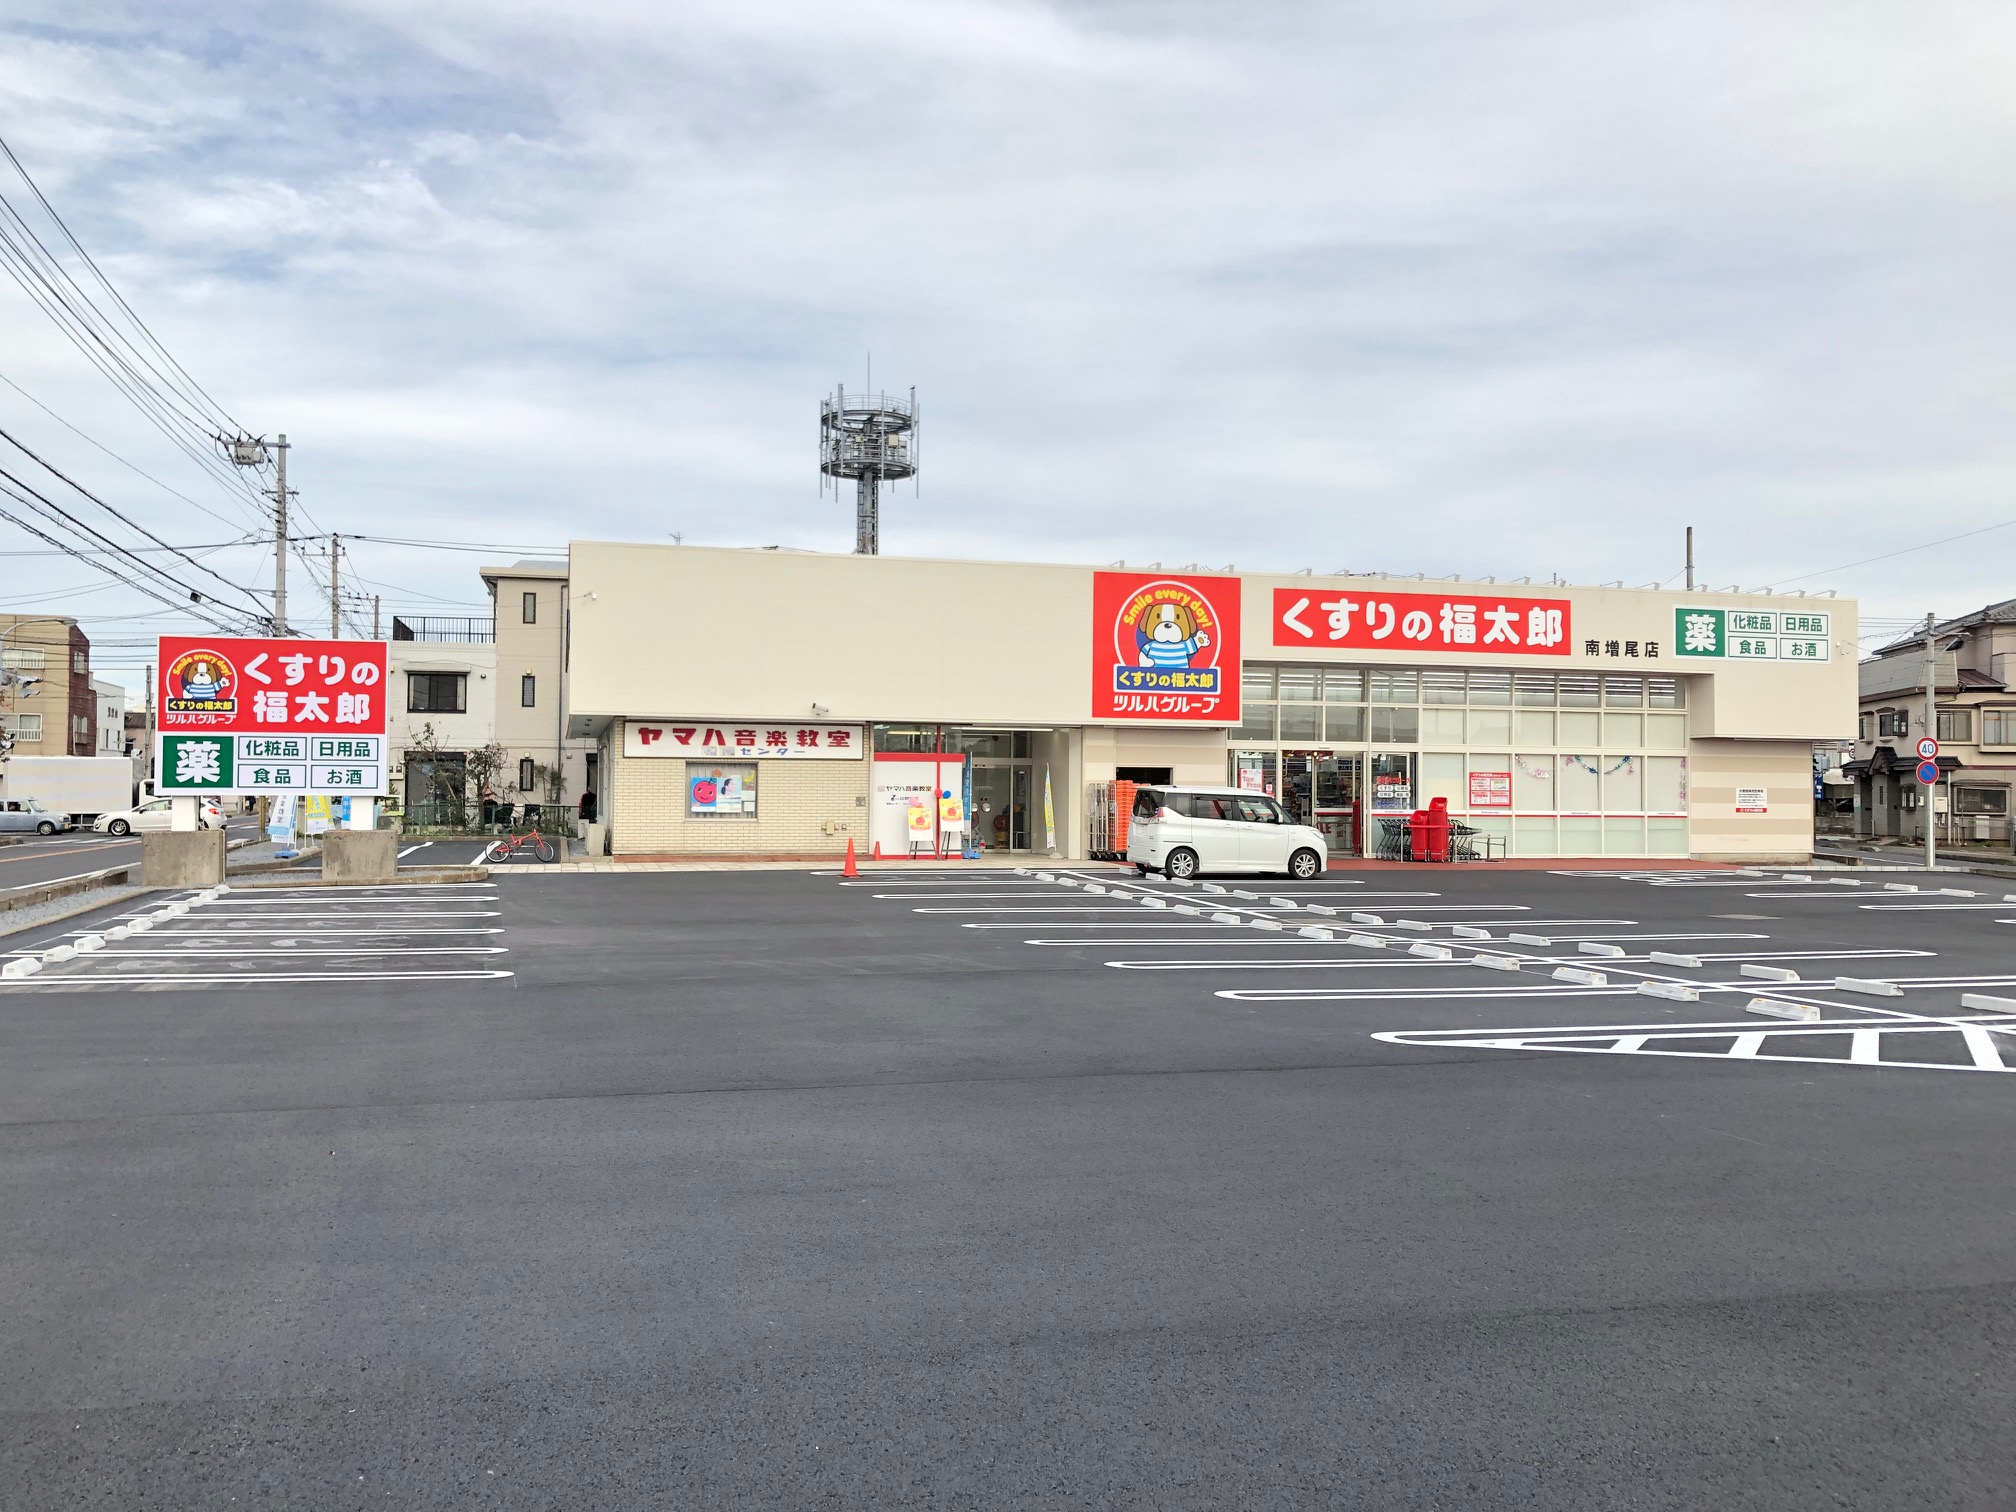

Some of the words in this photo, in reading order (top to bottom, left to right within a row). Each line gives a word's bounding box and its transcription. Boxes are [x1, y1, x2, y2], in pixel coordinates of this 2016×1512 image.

[1124, 594, 1153, 626] Smile
[1154, 589, 1191, 606] every
[1190, 601, 1213, 628] day!
[1283, 597, 1563, 648] くすりの福太郎
[1733, 614, 1772, 631] 化粧品
[1785, 617, 1822, 632] 日用品
[1685, 614, 1716, 652] 薬
[1585, 639, 1659, 658] 南増尾店
[1739, 640, 1767, 655] 食品
[1791, 642, 1817, 657] お酒
[172, 656, 193, 675] Smile
[193, 654, 218, 664] every
[217, 660, 232, 676] day!
[244, 652, 380, 686] くすりの
[1119, 671, 1214, 688] くすりの福太郎
[169, 700, 233, 711] くすりの福太郎
[253, 690, 371, 724] 福太郎
[1113, 695, 1220, 714] ツルハグループ
[166, 714, 237, 724] ツルハグループ
[638, 727, 850, 747] ヤマハ音楽教室
[246, 740, 299, 757] 化粧品
[320, 741, 371, 757] 日用品
[1921, 743, 1934, 754] 40
[175, 741, 221, 784] 薬
[253, 768, 291, 784] 食品
[327, 769, 362, 785] お酒
